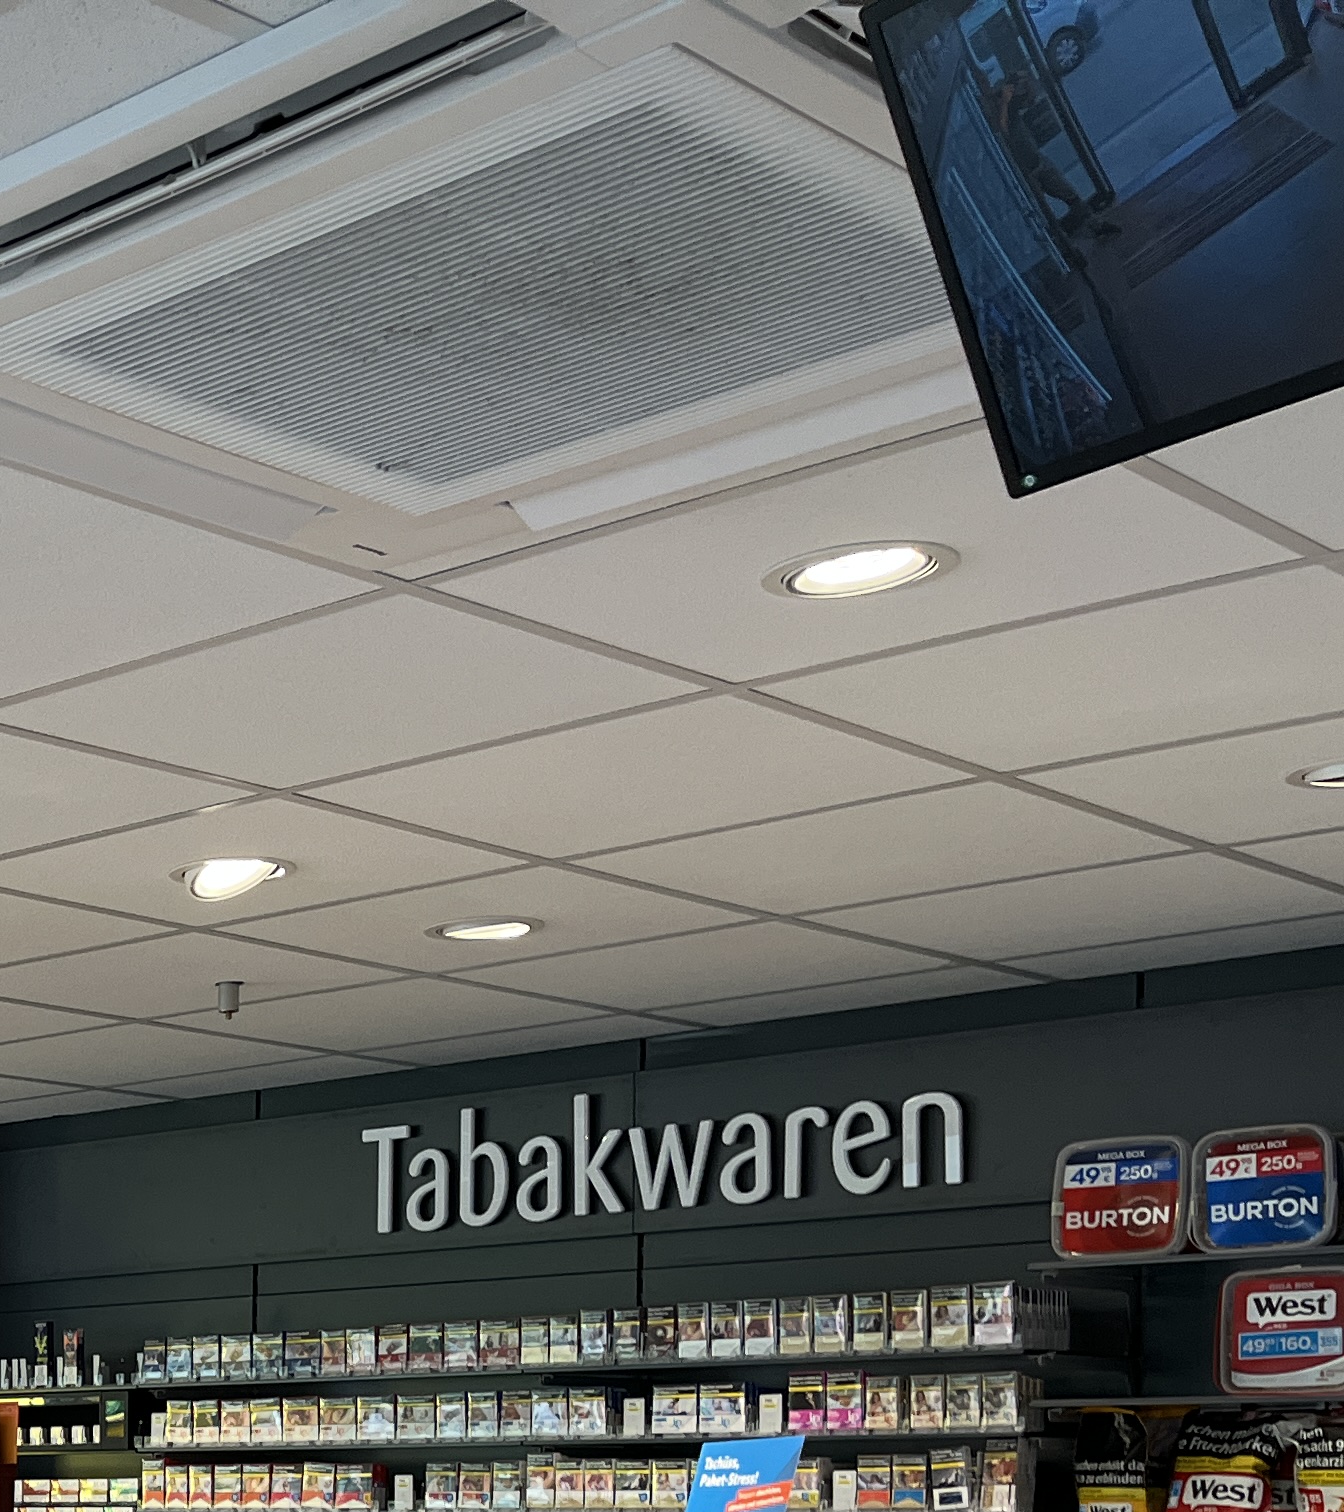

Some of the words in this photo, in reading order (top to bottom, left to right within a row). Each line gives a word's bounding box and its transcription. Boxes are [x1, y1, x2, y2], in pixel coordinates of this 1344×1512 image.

[1097, 1151, 1124, 1160] MEGA
[1126, 1150, 1146, 1159] BOX
[1237, 1143, 1266, 1152] MEGA
[1268, 1140, 1288, 1150] BOX
[361, 1091, 965, 1233] Tabakwaren
[1065, 1206, 1170, 1230] BURTON
[1211, 1196, 1318, 1223] BURTON
[1252, 1294, 1328, 1317] West
[700, 1471, 760, 1488] Paket-Stress!
[1190, 1479, 1258, 1504] West
